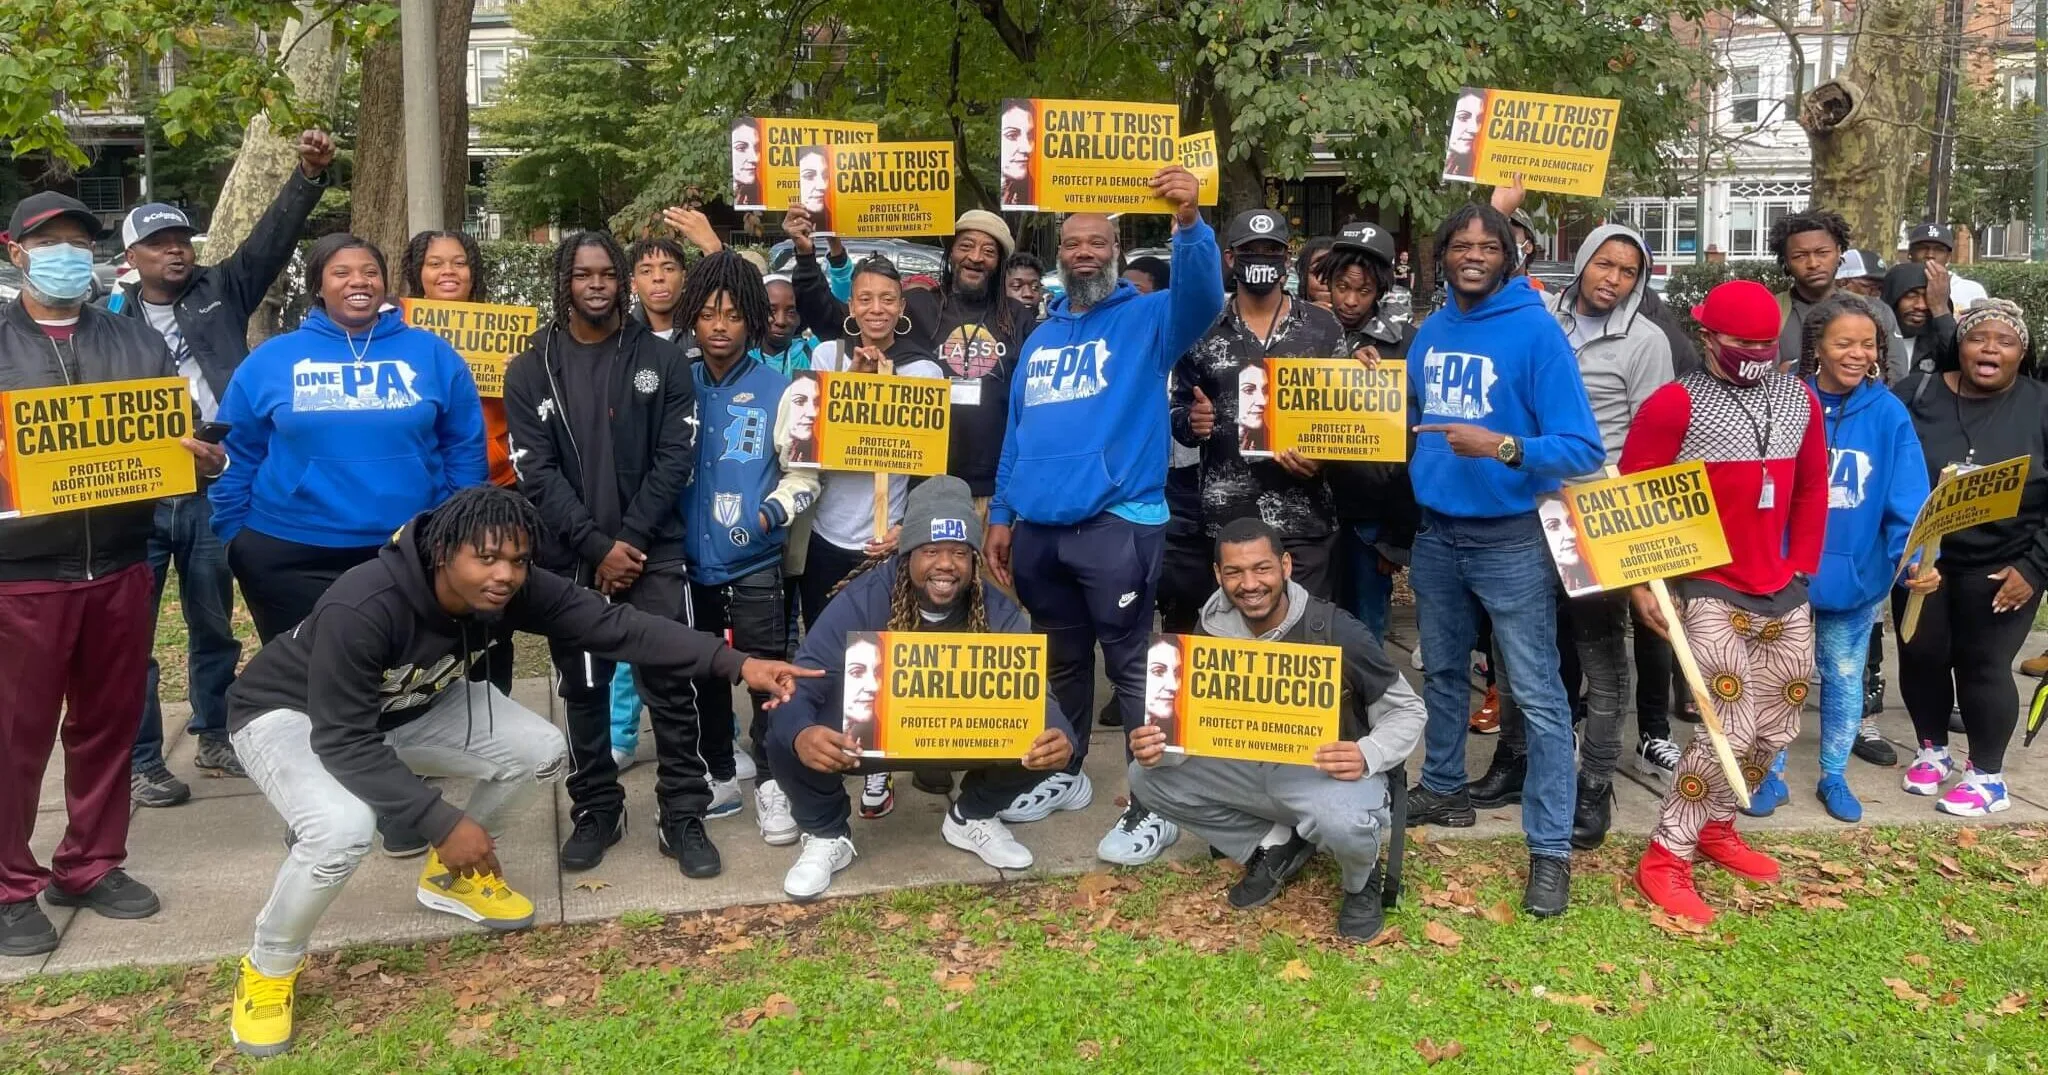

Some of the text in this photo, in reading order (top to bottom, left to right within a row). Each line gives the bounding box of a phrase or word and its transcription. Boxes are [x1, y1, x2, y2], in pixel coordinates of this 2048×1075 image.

[1044, 109, 1174, 136] CAN'T TRUST
[1492, 98, 1614, 128] CAN'T TRUST
[768, 126, 820, 145] CAN'T
[1488, 118, 1609, 151] CARLUCCIO
[1043, 133, 1174, 162] CARLUCCIO
[1179, 137, 1211, 155] UST
[836, 150, 949, 171] CAN'T TRUST
[1490, 153, 1594, 173] PROTECT PA DEMOCRACY
[836, 170, 950, 194] CARLUCCIO
[1052, 175, 1152, 187] PROTECT PA DEMOCR
[1528, 174, 1566, 185] NOVEMBER
[869, 203, 920, 213] PROTECT PA
[1064, 194, 1084, 204] VOTE
[1085, 194, 1096, 204] BY
[1098, 194, 1140, 205] NOVEMBER
[857, 212, 932, 223] ABORTION RIGHTS
[857, 224, 873, 233] VOTE
[885, 223, 922, 232] NOVEMBER
[1361, 227, 1376, 243] P
[1245, 265, 1275, 283] VOTE
[412, 307, 533, 333] CAN'T TRUST
[938, 341, 1007, 360] LASSO
[475, 373, 504, 383] RIGHT
[484, 363, 495, 373] PA
[1027, 344, 1098, 391] ONE PA
[1277, 367, 1402, 389] CAN'T TRUST
[295, 363, 410, 398] ONE PA
[1441, 355, 1483, 409] PA
[829, 380, 947, 406] CAN'T TRUST
[1277, 388, 1402, 413] CARLUCCIO
[14, 387, 185, 426] CAN'T TRUST
[827, 400, 945, 430] CARLUCCIO
[16, 411, 187, 456] CARLUCCIO
[1297, 433, 1380, 444] ABORTION RIGHTS
[1311, 423, 1366, 434] PROTECT PA
[859, 436, 911, 448] PROTECT PA
[1297, 445, 1315, 454] VOTE
[1317, 446, 1326, 454] BY
[1328, 447, 1368, 455] NOVEMBER
[844, 457, 861, 466] VOTE
[863, 458, 872, 467] BY
[873, 459, 911, 469] NOVEMBER
[845, 446, 923, 460] ABORTION RIGHTS
[69, 457, 143, 477] PROTECT PA
[1956, 463, 2024, 490] TRUST
[51, 466, 162, 492] ABORTION RIGHTS
[52, 494, 77, 506] VOTE
[80, 491, 92, 501] BY
[95, 485, 148, 499] NOVEMBER
[1576, 469, 1701, 514] CAN'T TRUST
[1583, 491, 1710, 539] CARLUCCIO
[945, 519, 965, 539] PA
[1619, 542, 1698, 569] ABORTION RIGHTS
[1628, 535, 1681, 555] PROTECT PA
[1623, 569, 1640, 580] VOTE
[1642, 566, 1652, 576] BY
[1652, 559, 1691, 574] NOVEMBER
[893, 643, 1041, 670] CAN'T TRUST
[1192, 647, 1336, 680] CAN'T TRUST
[892, 669, 1040, 700] CARLUCCIO
[1191, 671, 1335, 709] CARLUCCIO
[900, 716, 1029, 730] PROTECT PA DEMOCRACY
[1199, 716, 1324, 737] PROTECT PA DEMOCRACY
[914, 737, 936, 748] VOTE
[938, 737, 950, 748] BY
[952, 737, 1000, 748] NOVEMBER
[1212, 737, 1234, 748] VOTE
[1235, 738, 1246, 749] BY
[1248, 740, 1295, 753] NOVEMBER
[968, 827, 992, 848] N
